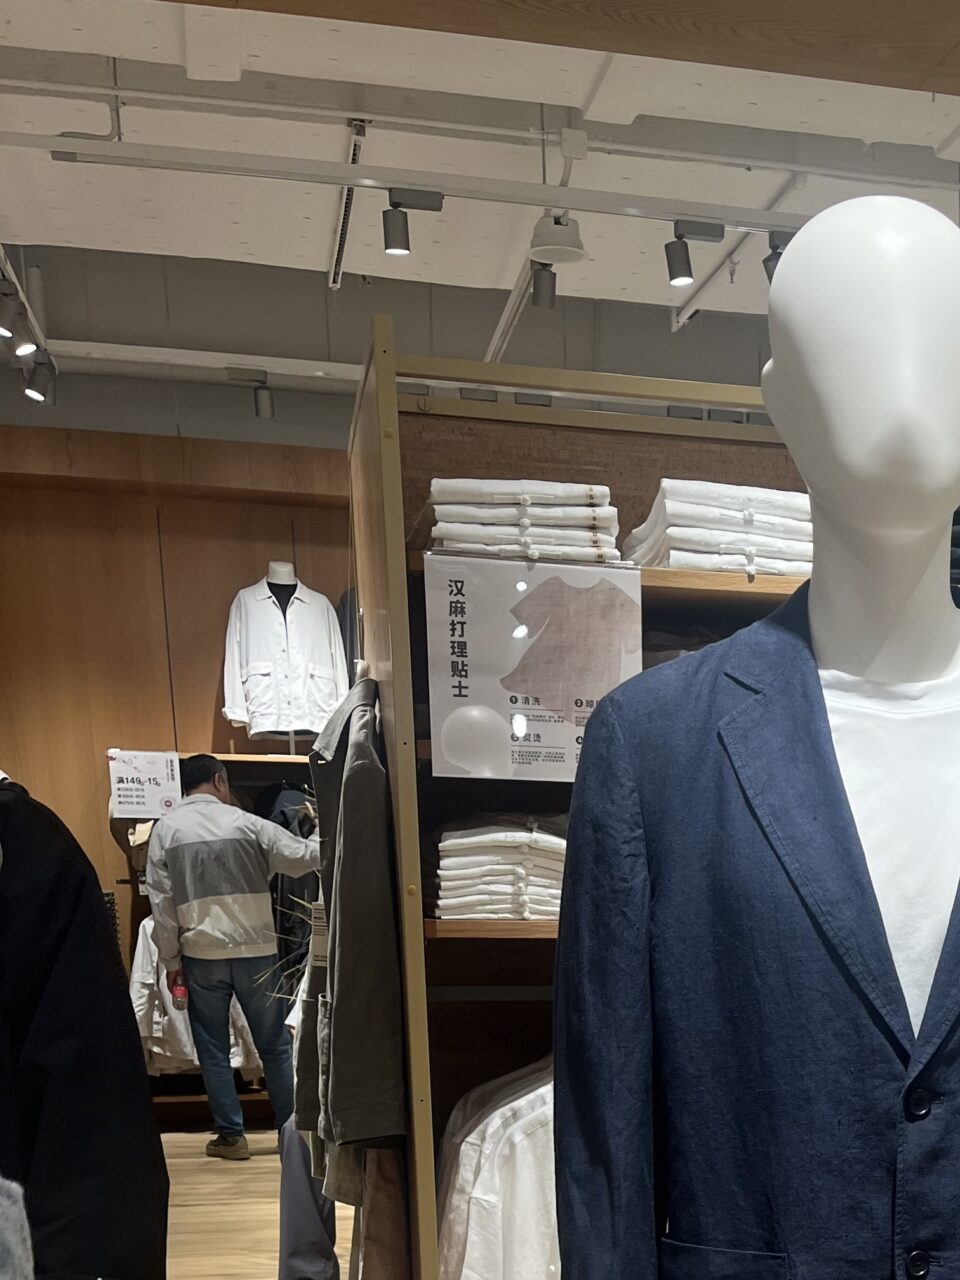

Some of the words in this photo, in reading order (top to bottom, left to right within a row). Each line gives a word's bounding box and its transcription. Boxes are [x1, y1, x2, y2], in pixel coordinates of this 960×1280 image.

[448, 579, 469, 698] 汉麻打理贴士
[522, 696, 541, 706] 清洗
